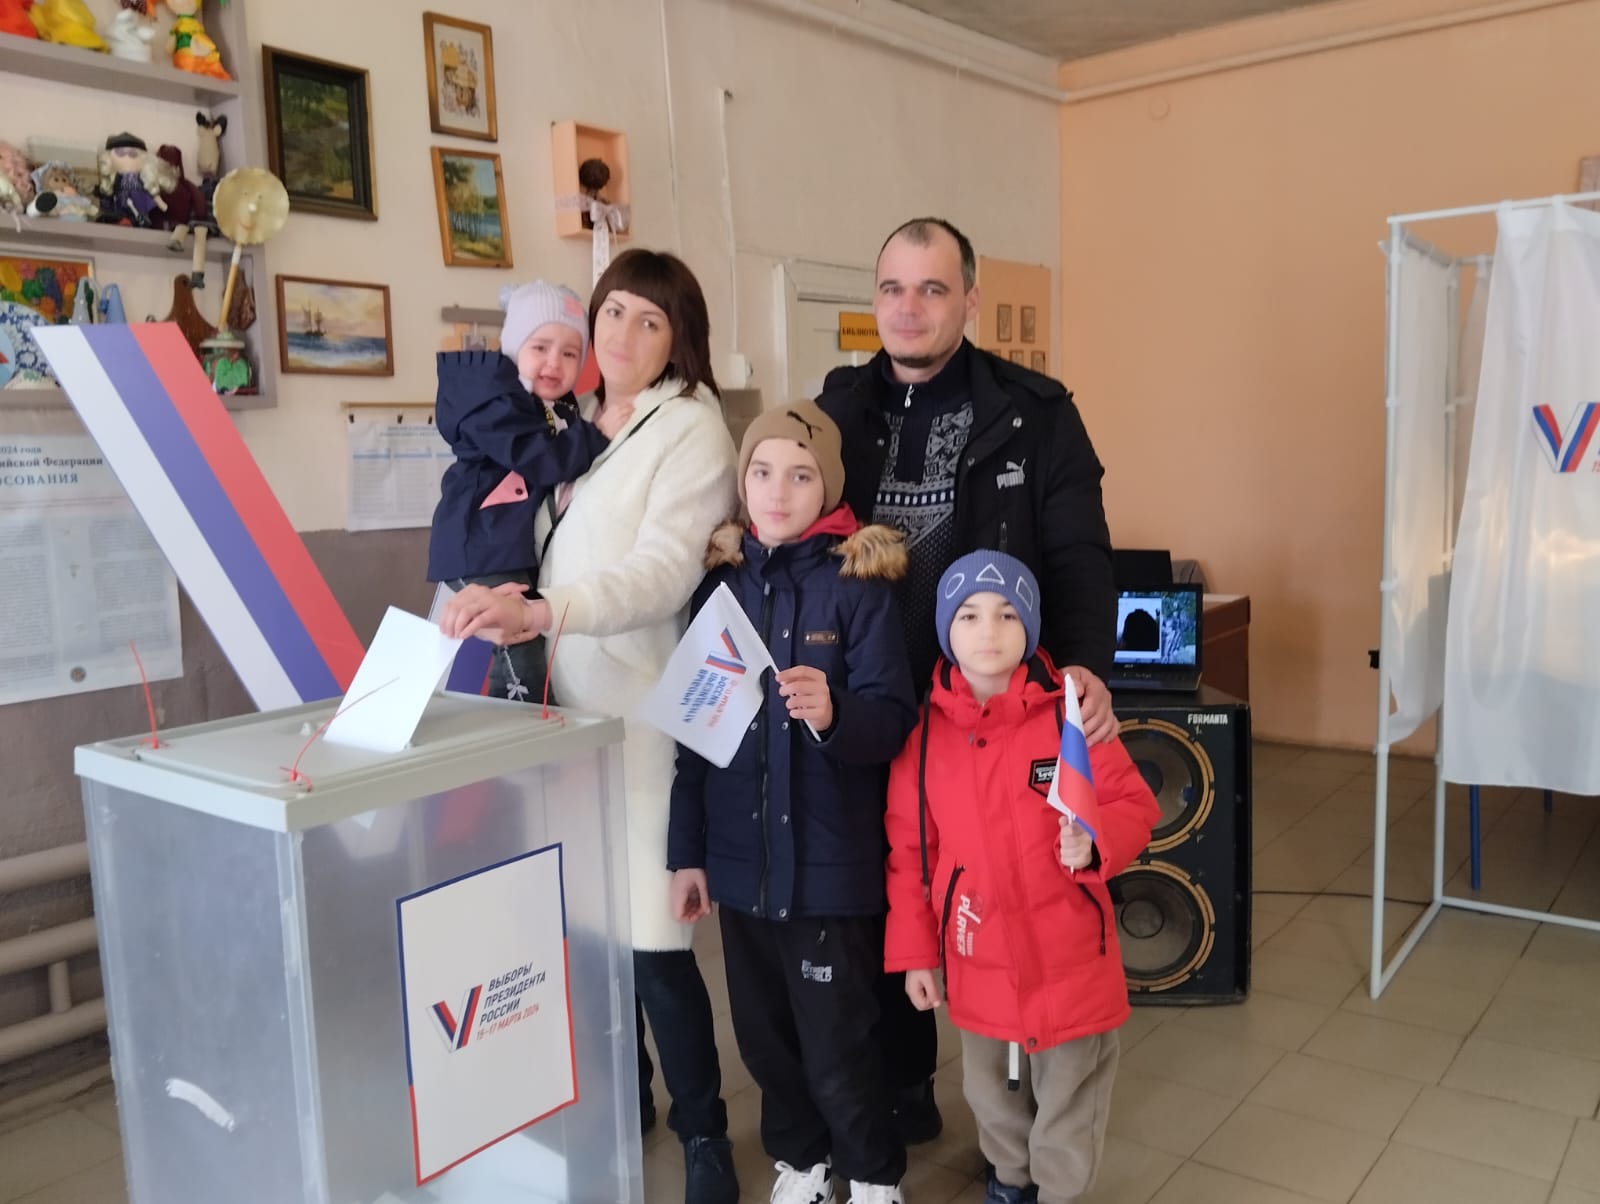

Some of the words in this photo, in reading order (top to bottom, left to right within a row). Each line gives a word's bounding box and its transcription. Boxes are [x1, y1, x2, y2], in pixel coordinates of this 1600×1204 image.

[43, 457, 103, 469] Федерации
[1187, 713, 1229, 725] FORMANTA
[483, 970, 546, 1009] ПРЕЗИДЕНТА
[488, 961, 533, 992] ВЫБОРЫ
[479, 997, 521, 1027] РОССИИ
